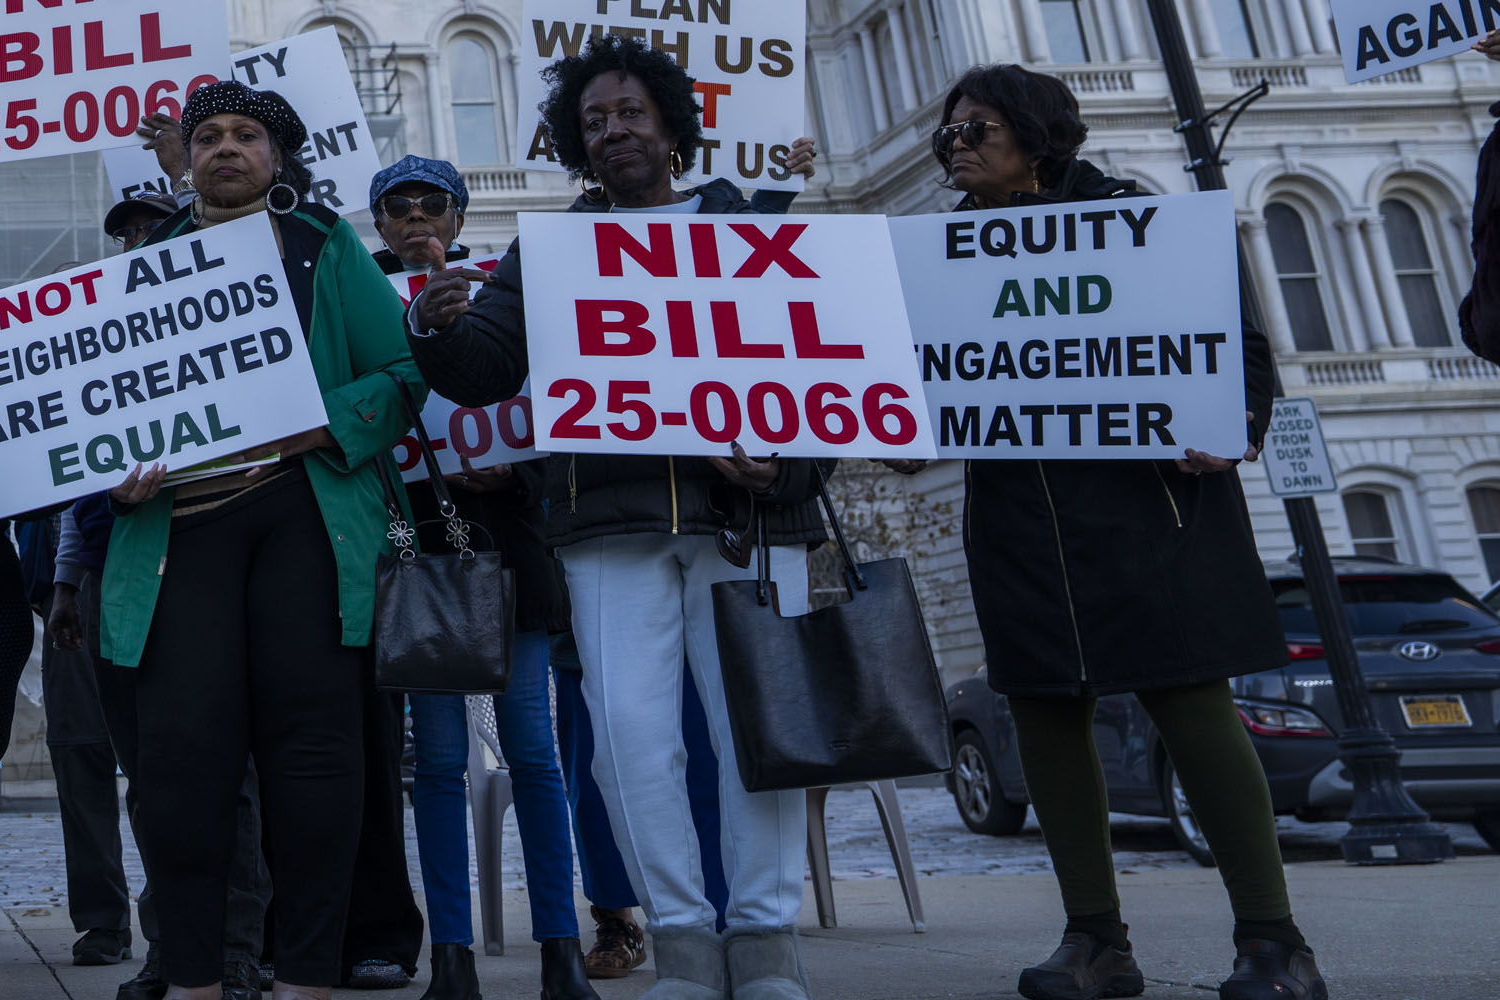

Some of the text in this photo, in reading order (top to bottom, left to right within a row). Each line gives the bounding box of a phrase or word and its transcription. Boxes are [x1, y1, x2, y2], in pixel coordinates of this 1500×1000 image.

[715, 35, 794, 77] US
[737, 141, 792, 181] US
[594, 222, 821, 278] NIX
[946, 207, 1158, 260] EQUITY
[125, 239, 225, 294] ALL
[992, 275, 1112, 318] AND
[574, 299, 865, 359] BILL
[81, 326, 293, 416] CREATED
[914, 332, 1226, 382] NGAGEMENT
[547, 378, 917, 446] 25-0066
[940, 403, 1176, 446] MATTER
[1268, 419, 1313, 432] LOSED
[1274, 406, 1301, 417] ARK
[48, 403, 242, 487] EQUAL
[1272, 433, 1310, 446] FROM
[1276, 448, 1313, 460] DUSK
[1283, 475, 1322, 488] DAWN
[1290, 461, 1307, 472] TO
